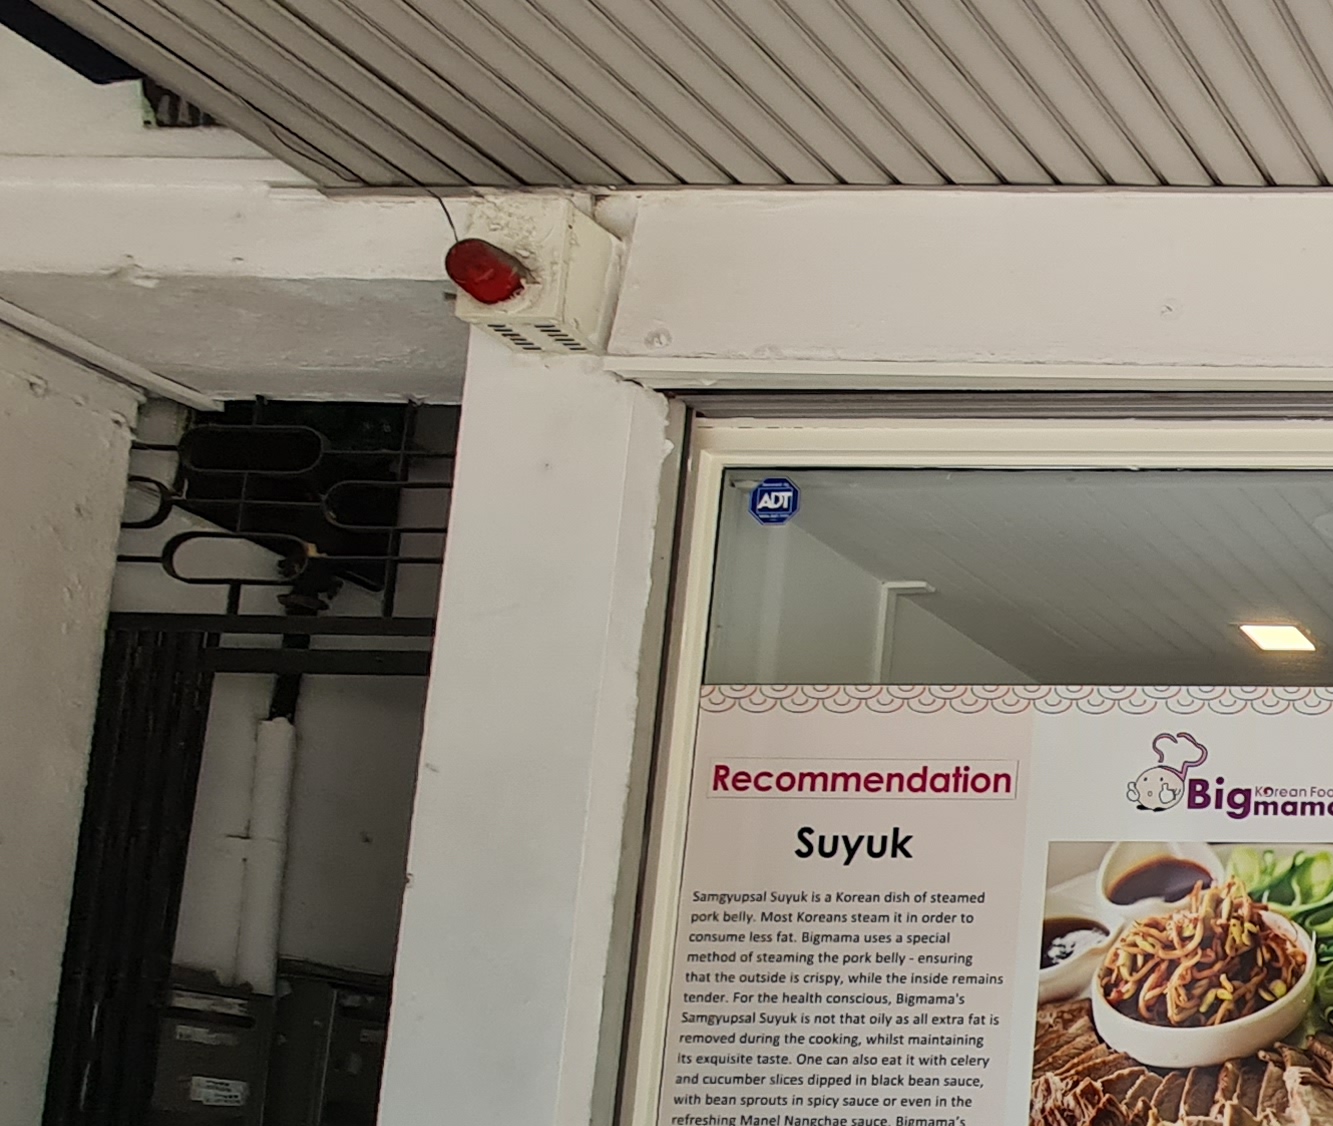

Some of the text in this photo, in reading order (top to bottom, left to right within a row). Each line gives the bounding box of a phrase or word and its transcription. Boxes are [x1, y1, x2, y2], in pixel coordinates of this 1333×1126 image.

[757, 491, 793, 509] ADT
[712, 764, 1013, 793] Recommendation
[1255, 786, 1307, 798] Korean
[795, 826, 914, 866] Suyuk
[692, 890, 986, 905] Samgyupsal Suyuk is a Korean dish of steamed
[691, 911, 974, 925] pork belly. Most Koreans steam it in order to
[688, 930, 951, 946] consume less fat. Bigmama uses a special
